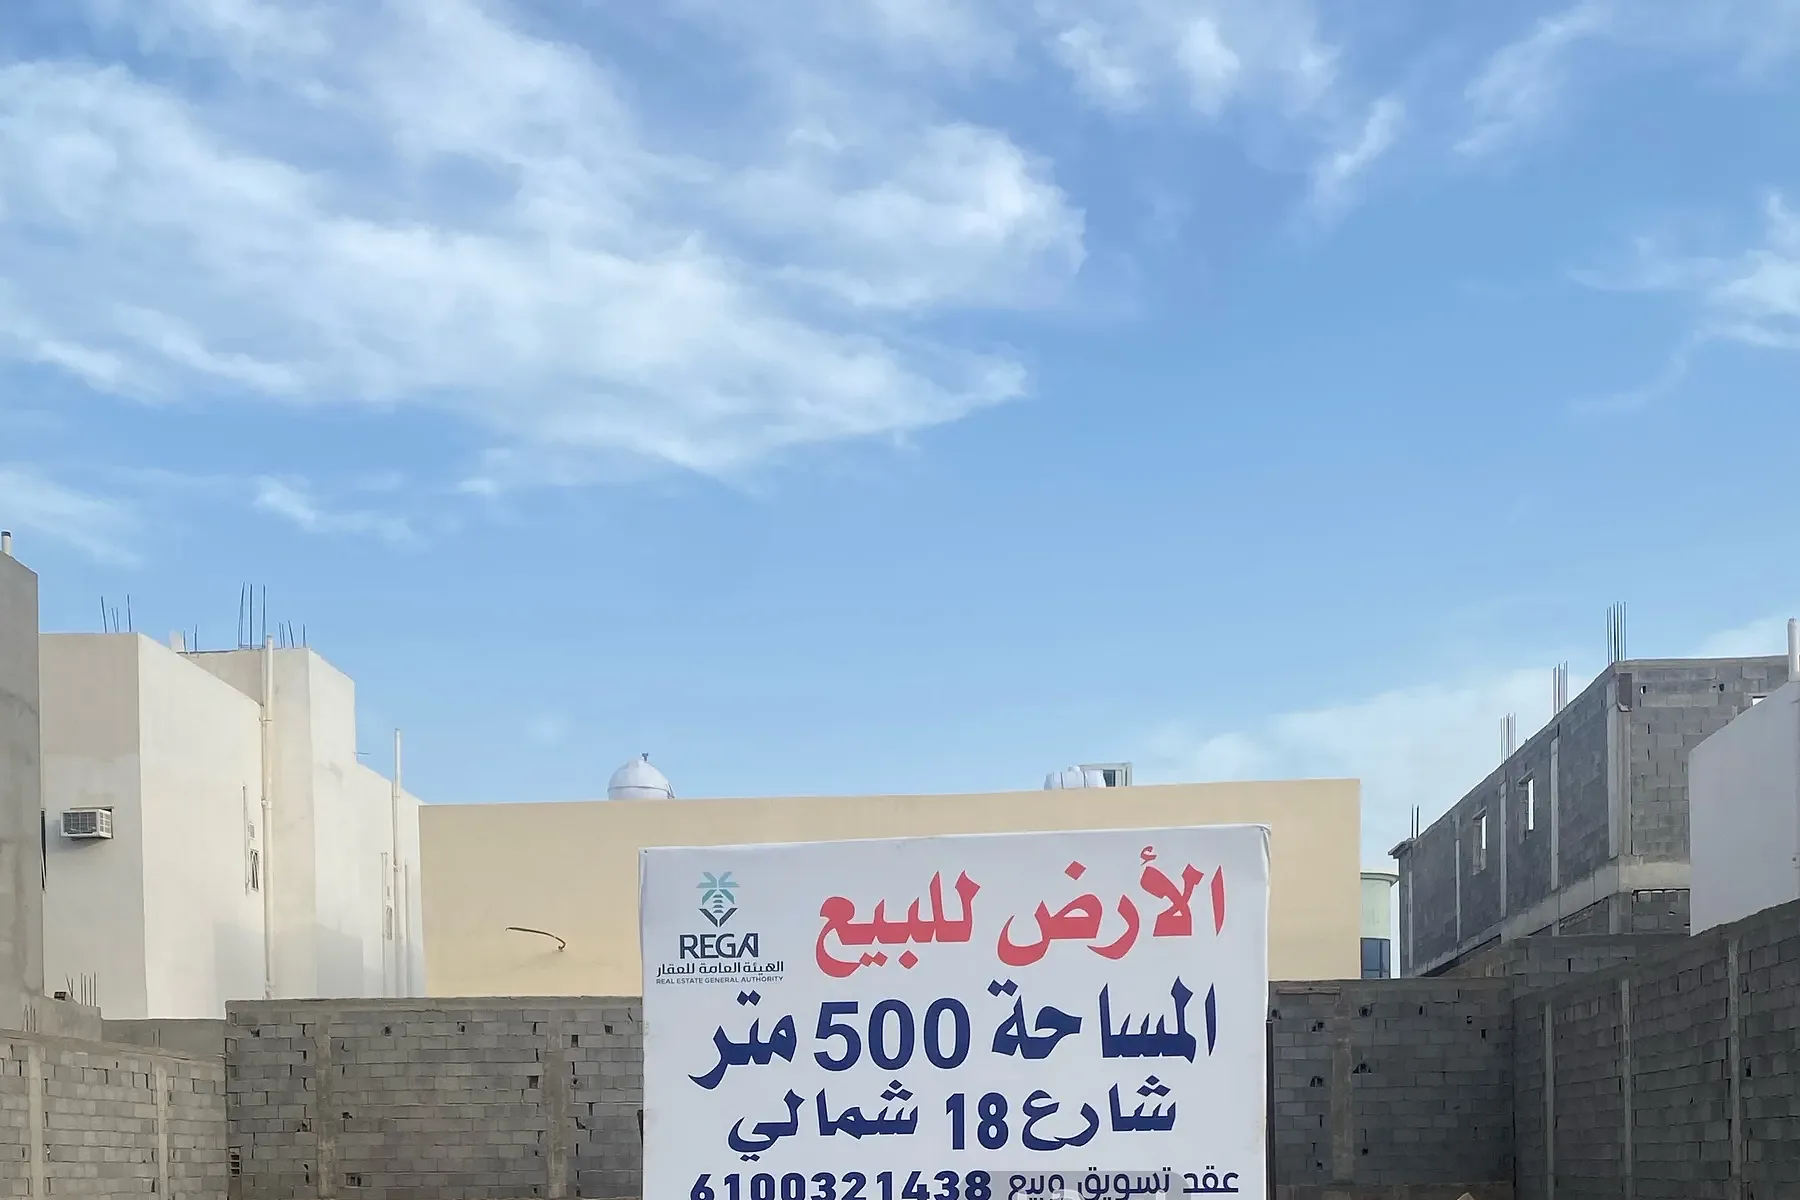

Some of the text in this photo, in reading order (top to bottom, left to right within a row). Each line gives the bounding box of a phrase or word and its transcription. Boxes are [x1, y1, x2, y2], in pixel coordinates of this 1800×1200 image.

[815, 846, 1226, 979] الأرض للبيع
[679, 933, 759, 959] REGA
[656, 960, 784, 978] الهيئة العامة للعقار
[705, 976, 739, 984] GENERAL
[740, 975, 784, 983] AUTHORITY
[688, 976, 1218, 1090] المساحة 500 متر
[727, 1074, 1177, 1162] شارع 18 شمالي
[1182, 1165, 1240, 1194] عقد
